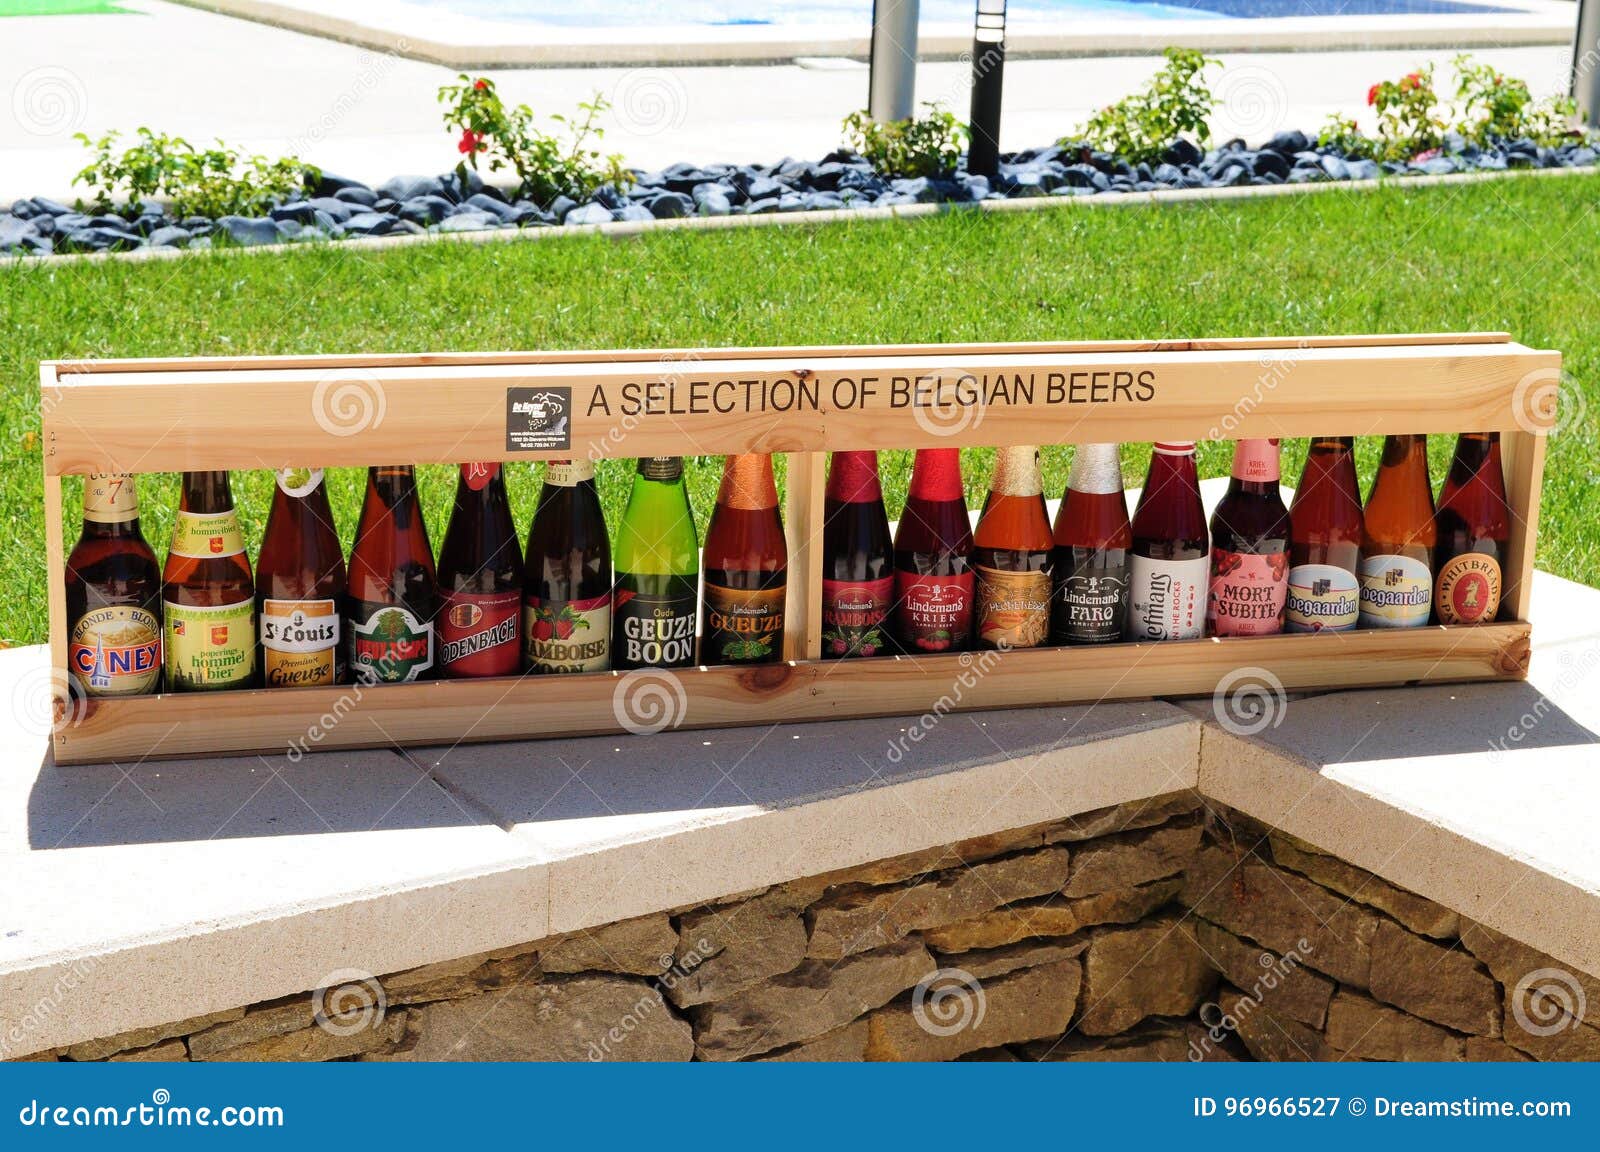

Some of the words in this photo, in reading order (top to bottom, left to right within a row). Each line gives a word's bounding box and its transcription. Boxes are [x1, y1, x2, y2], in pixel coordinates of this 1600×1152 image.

[587, 384, 611, 416] A
[620, 378, 820, 416] SELECTION
[832, 376, 879, 409] OF
[890, 373, 1035, 408] BELGIAN
[1046, 370, 1156, 404] BEERS
[108, 480, 123, 504] 7
[1441, 560, 1498, 596] WHITBREAD
[1173, 580, 1182, 611] ROCKS
[1223, 583, 1275, 602] MORT
[1360, 585, 1430, 608] oegaarden
[653, 607, 675, 617] Oude
[912, 612, 957, 623] KRIEK
[1070, 606, 1114, 621] FARO
[1218, 600, 1277, 620] SUBITE
[74, 611, 113, 640] BLONDE
[281, 623, 335, 643] Louis
[624, 612, 696, 641] GEUZE
[710, 612, 783, 633] GUEUZE
[1068, 620, 1095, 628] LAMBIC
[441, 612, 517, 665] ODENBACH
[528, 637, 606, 662] AMBOISE
[626, 635, 693, 664] BOON
[191, 650, 246, 668] hommel
[207, 666, 235, 680] bier
[269, 663, 331, 685] Gueuze
